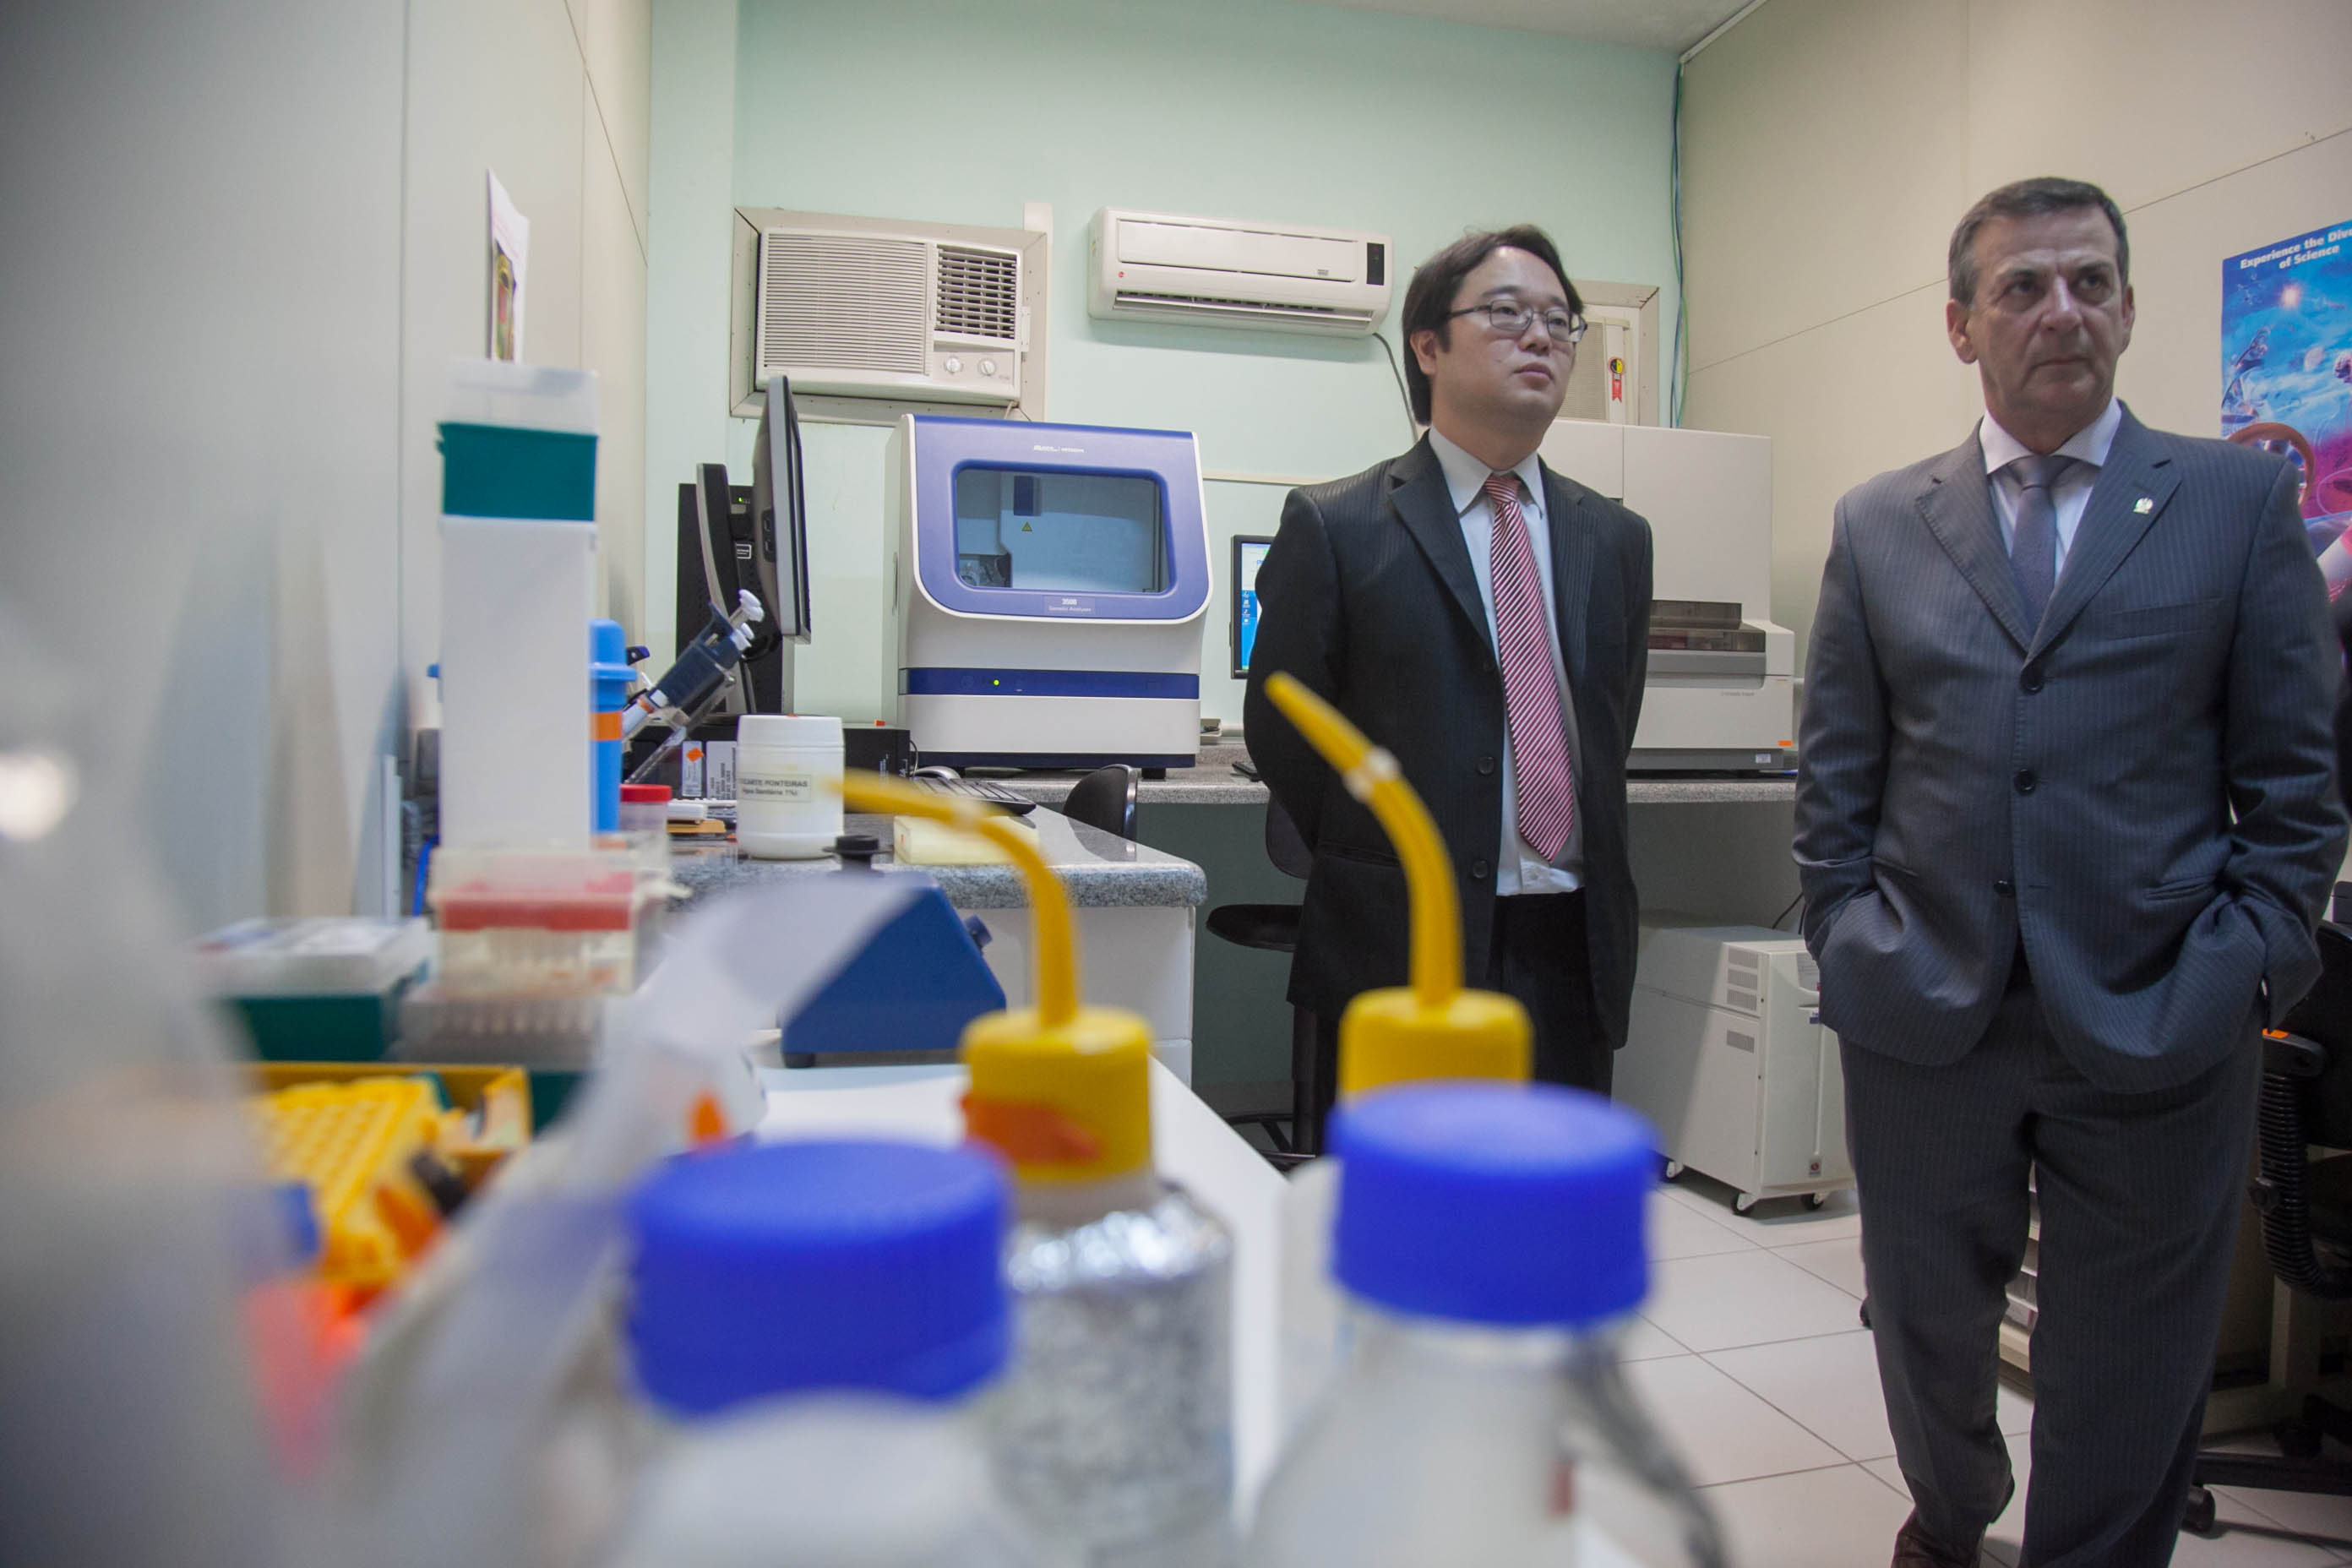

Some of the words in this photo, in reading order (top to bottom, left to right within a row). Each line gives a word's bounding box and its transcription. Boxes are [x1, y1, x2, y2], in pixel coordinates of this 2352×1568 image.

[2240, 244, 2300, 269] Experience
[2304, 237, 2325, 249] the
[2278, 256, 2291, 269] of
[2294, 245, 2340, 264] Science
